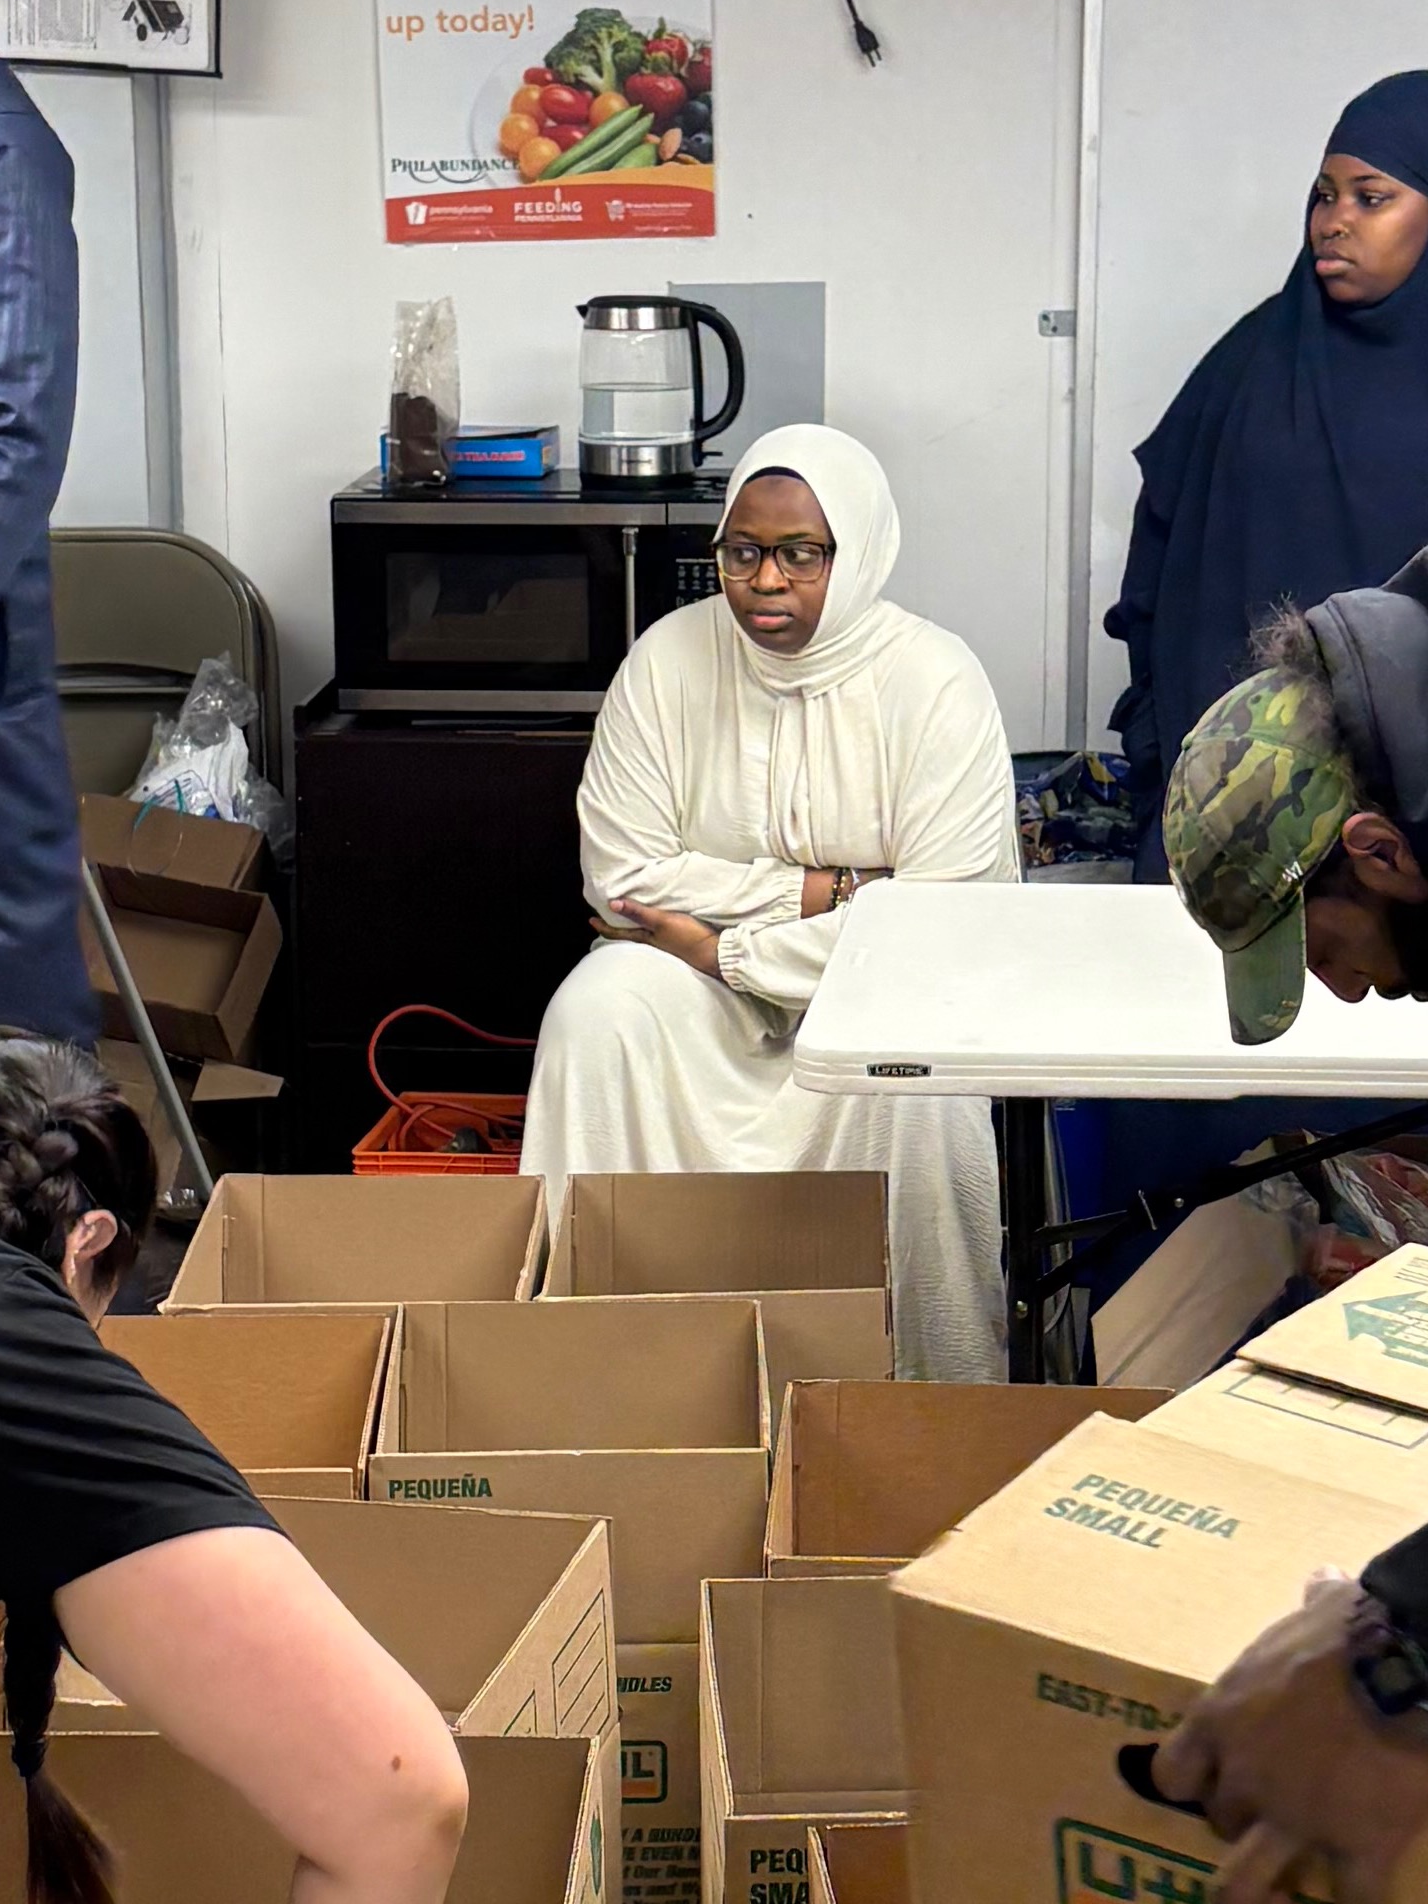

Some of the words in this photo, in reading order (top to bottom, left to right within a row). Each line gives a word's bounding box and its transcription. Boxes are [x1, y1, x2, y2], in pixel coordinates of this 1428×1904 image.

[386, 14, 425, 41] up
[435, 4, 535, 39] today!
[514, 201, 583, 214] FEEDING
[388, 1473, 493, 1500] PEQUEÑA
[1043, 1496, 1170, 1549] SMALL
[1072, 1473, 1242, 1540] PEQUEÑA
